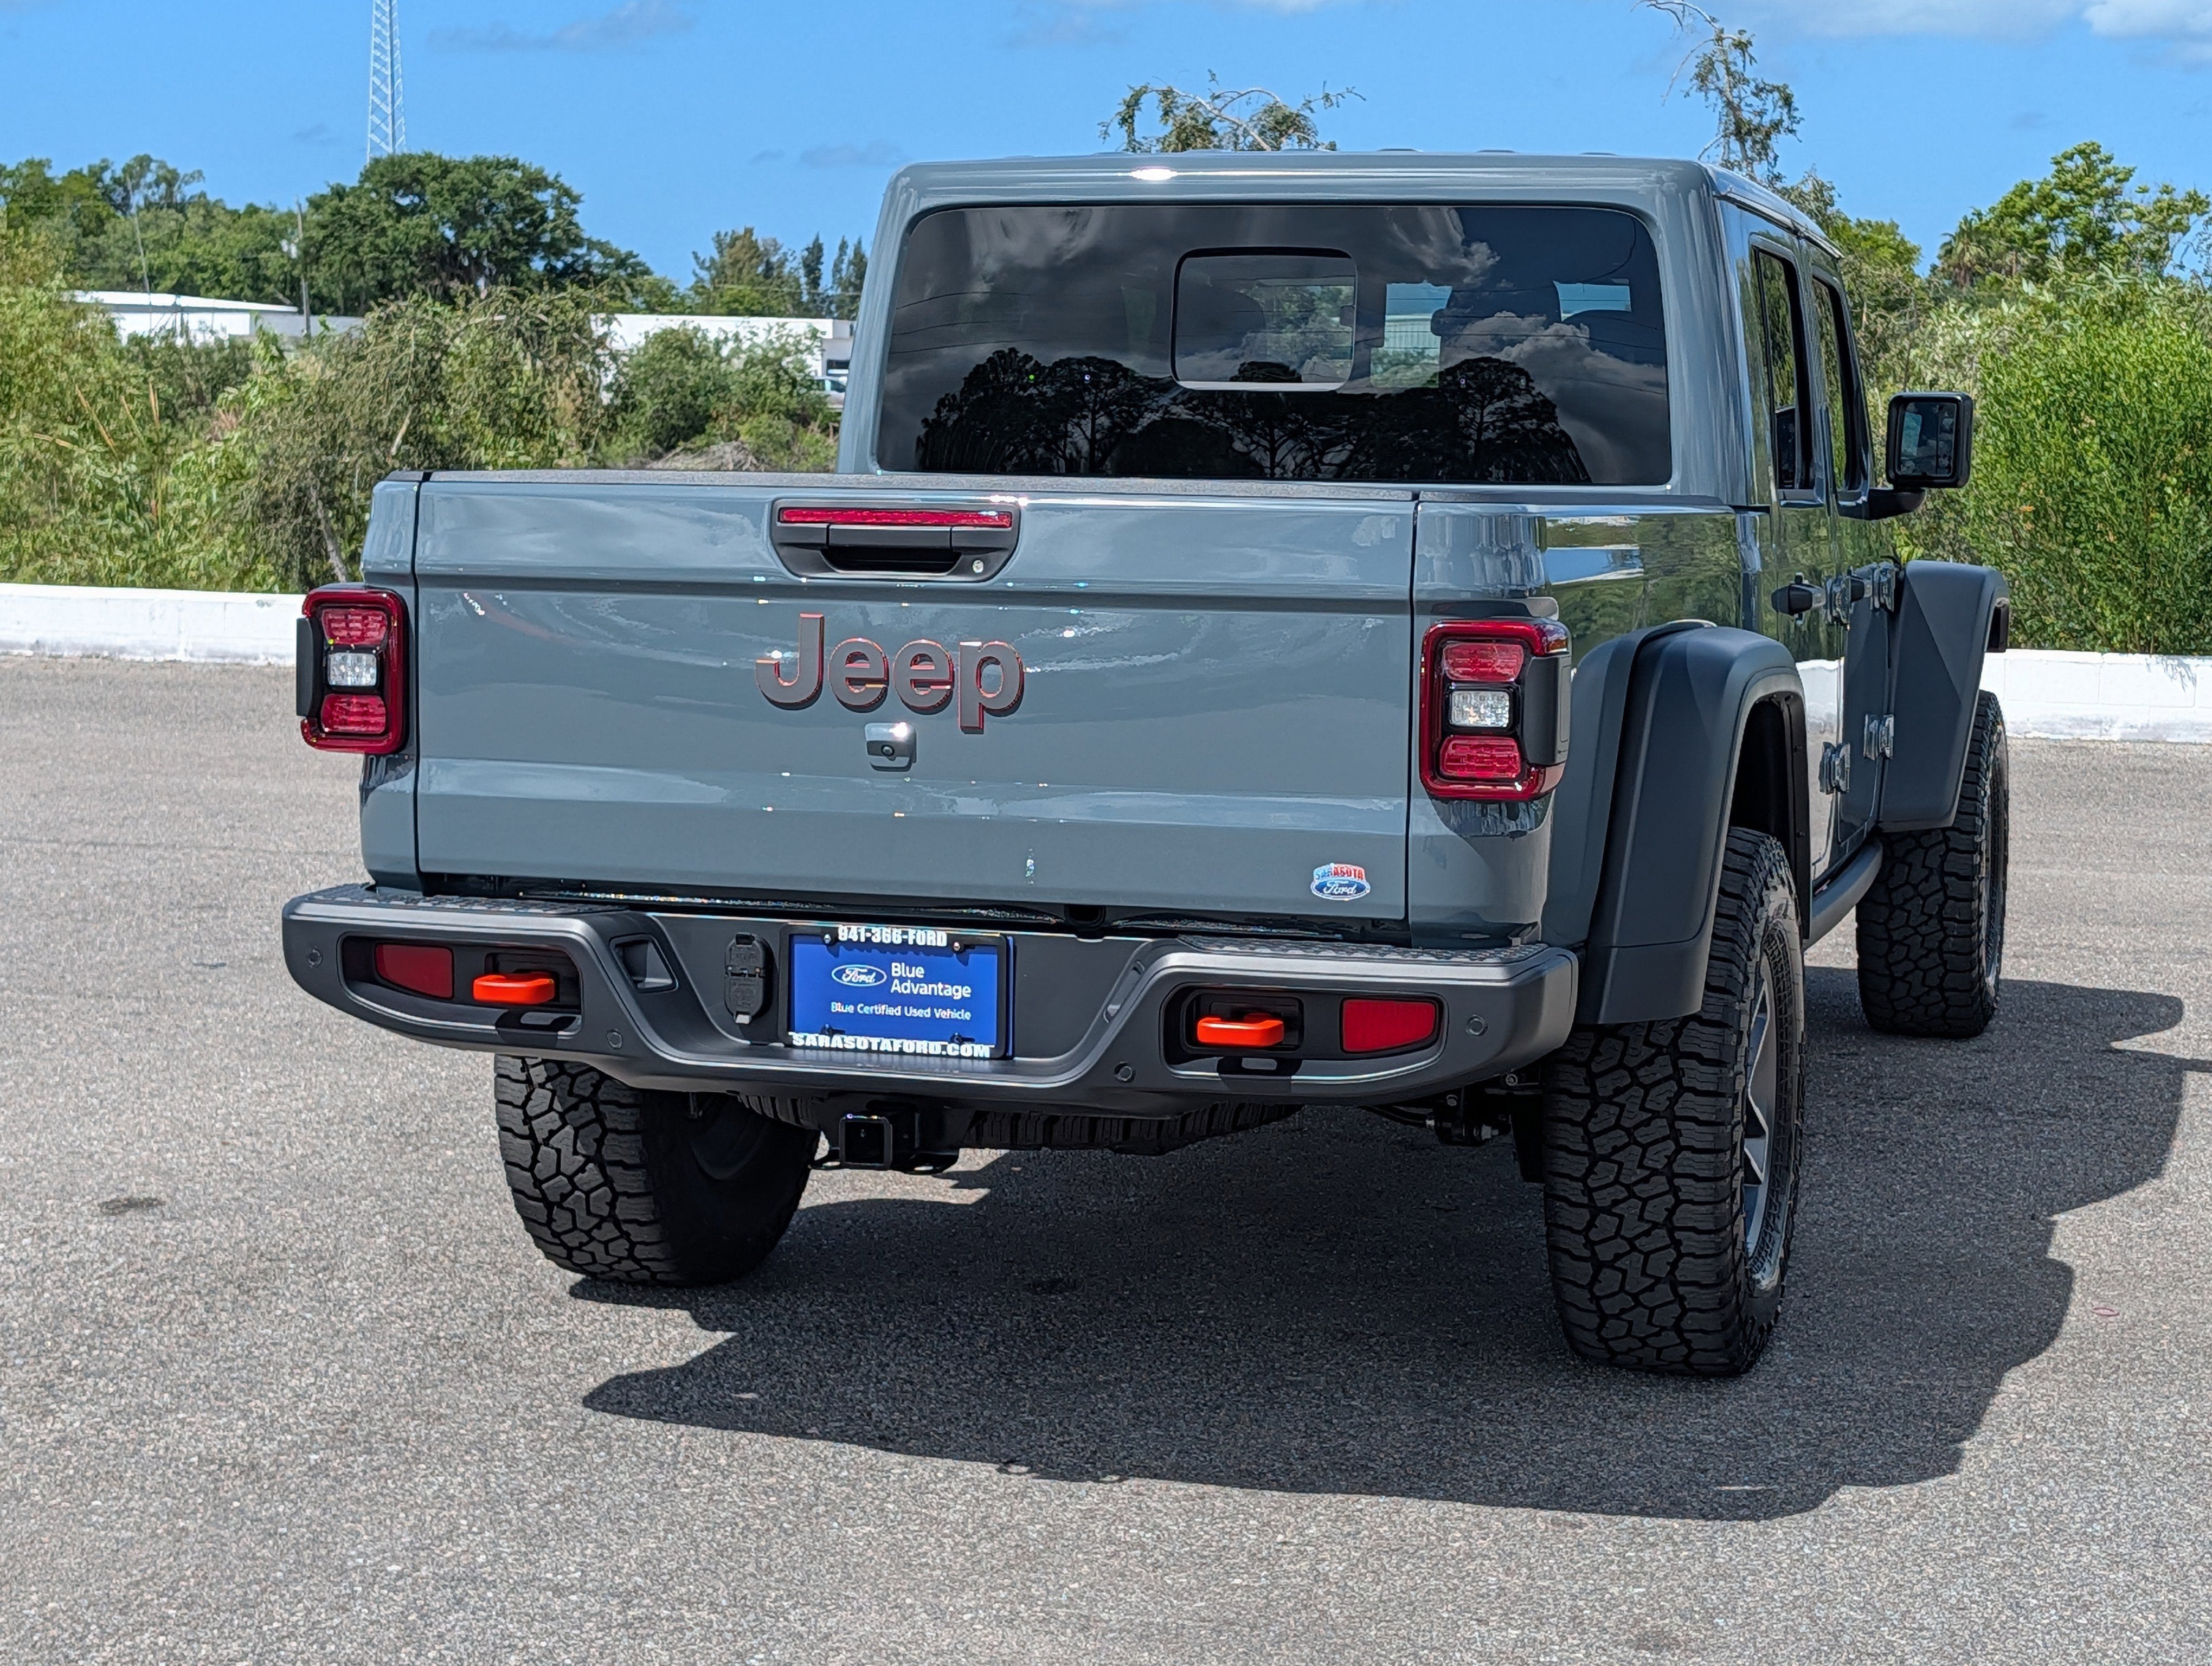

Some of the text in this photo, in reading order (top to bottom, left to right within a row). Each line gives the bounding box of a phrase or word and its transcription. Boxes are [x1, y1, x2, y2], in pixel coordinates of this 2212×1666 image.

[756, 613, 1025, 734] Jeep
[1323, 880, 1358, 894] Ford
[838, 925, 948, 947] 941-366-FORD
[841, 967, 876, 984] Ford
[891, 962, 925, 978] Blue
[890, 978, 972, 999] Advantage
[831, 1002, 972, 1021] Blue Certified Used Vehicle
[792, 1033, 991, 1059] SARASOTAFORD.COM
